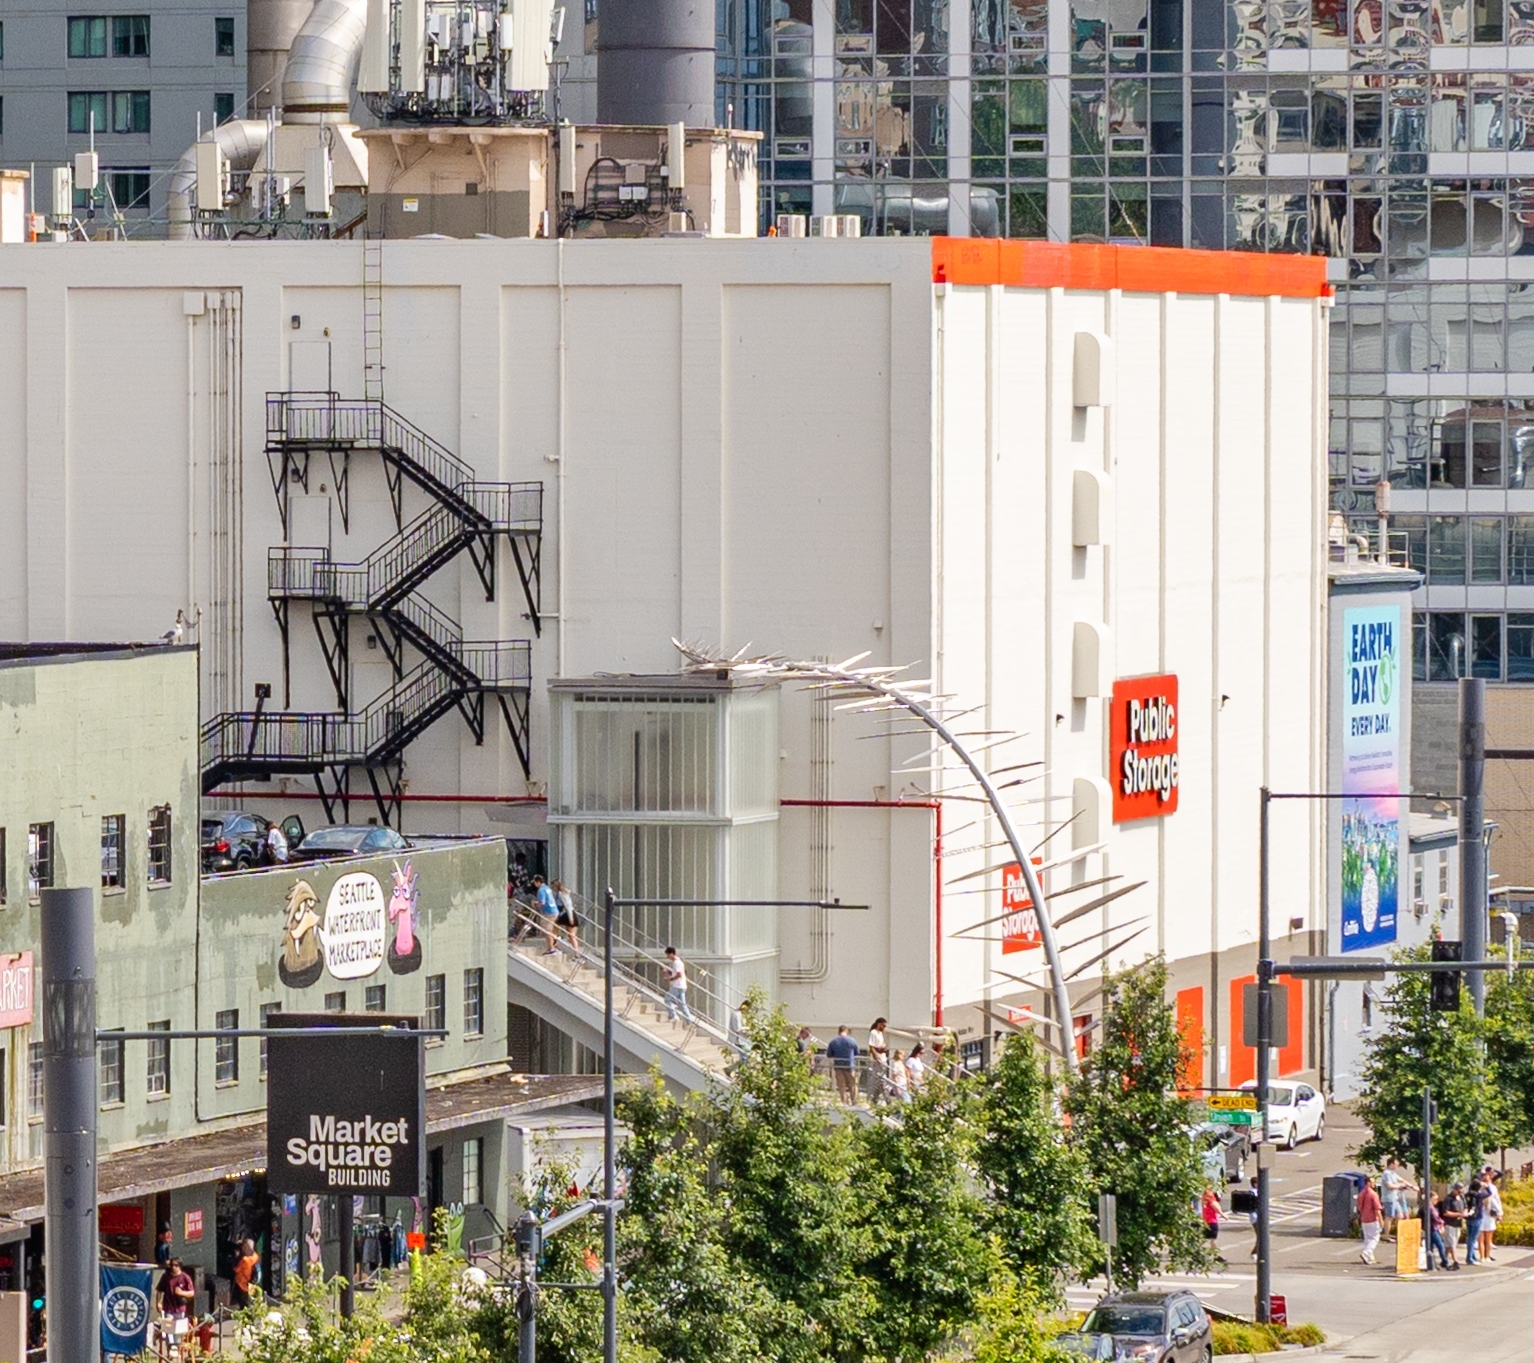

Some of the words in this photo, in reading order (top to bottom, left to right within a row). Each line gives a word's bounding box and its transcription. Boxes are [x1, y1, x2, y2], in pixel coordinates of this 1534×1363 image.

[1351, 622, 1392, 662] EARTH
[1351, 665, 1378, 705] DAY
[1129, 696, 1176, 743] Public
[1351, 715, 1373, 736] EVERY
[1123, 748, 1179, 802] Storage
[339, 882, 375, 906] SEATTLE
[328, 909, 381, 936] WATERFRONT
[328, 938, 382, 967] MARKETPLACE
[309, 1114, 408, 1144] Market
[286, 1137, 392, 1171] Square
[328, 1168, 391, 1187] BUILDING
